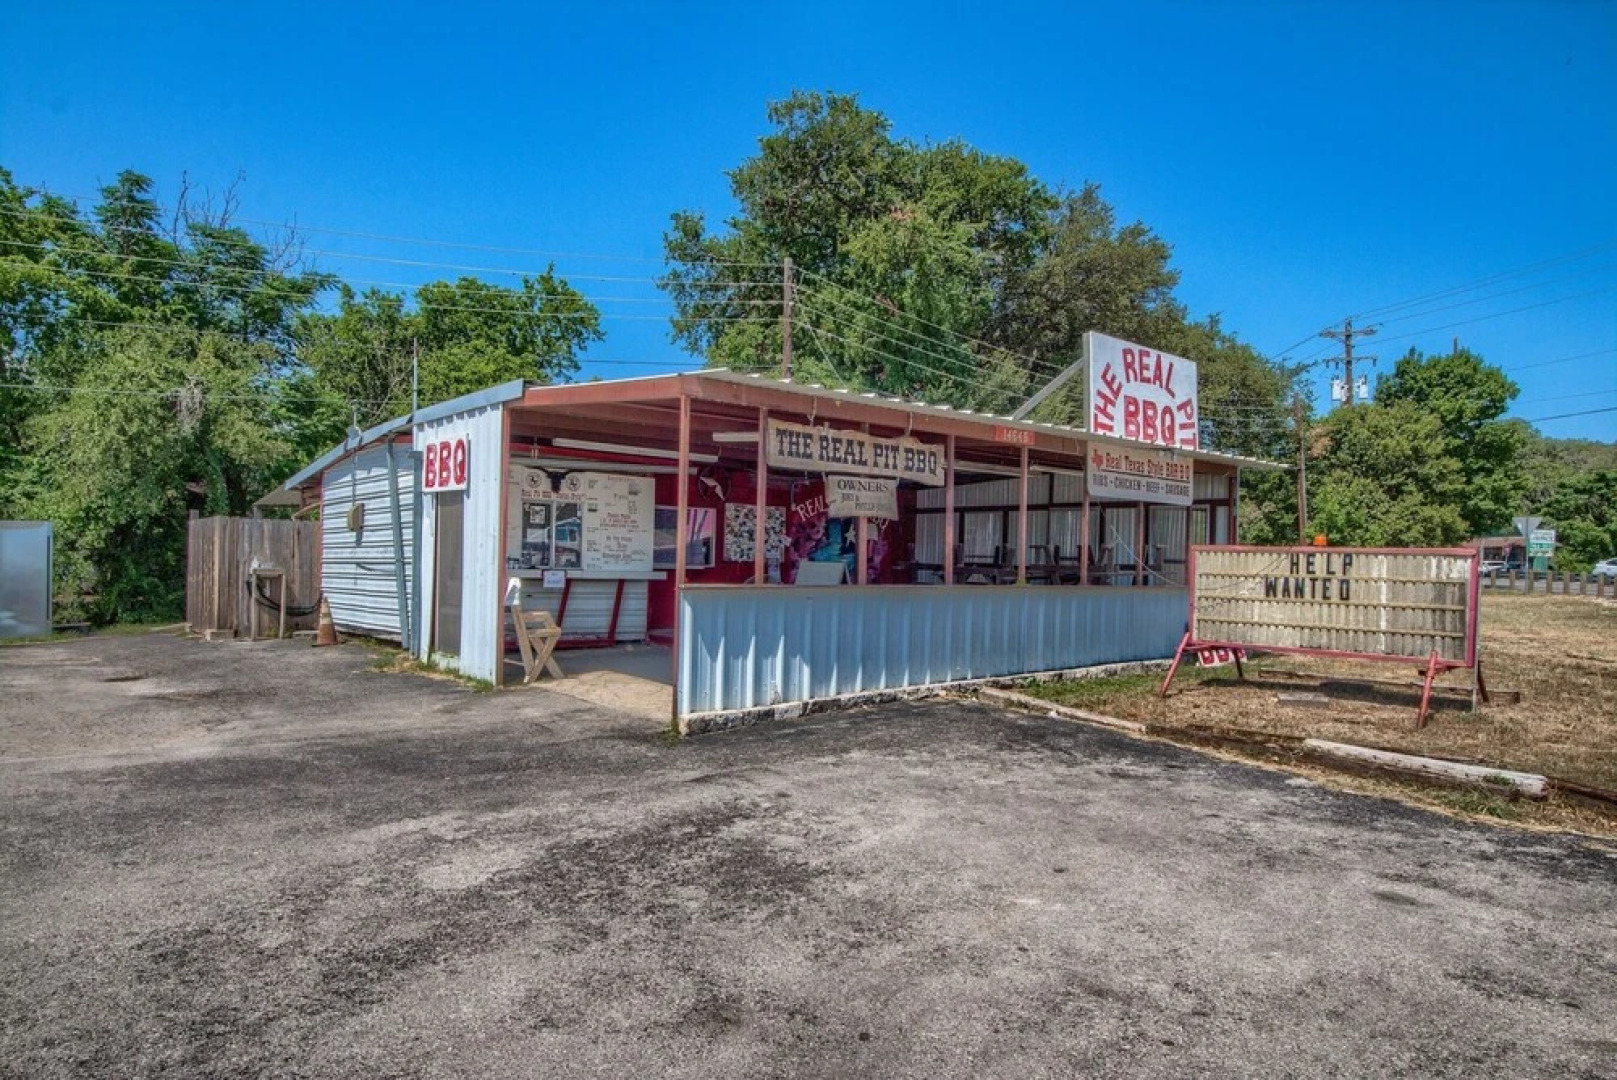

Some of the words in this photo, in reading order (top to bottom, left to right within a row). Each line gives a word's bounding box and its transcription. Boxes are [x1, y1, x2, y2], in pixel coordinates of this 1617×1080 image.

[1093, 361, 1123, 433] THE
[1122, 347, 1176, 399] REAL
[1177, 398, 1197, 448] PIT
[1123, 395, 1176, 446] BBQ
[425, 438, 467, 488] BBQ
[775, 427, 813, 460] THE
[818, 434, 868, 467] REAL
[872, 441, 900, 470] PIT
[903, 447, 937, 477] BBQ
[1106, 452, 1122, 470] Real
[1124, 455, 1144, 473] Texas
[837, 479, 889, 493] OWNERS
[1113, 476, 1141, 491] CHICKEN
[796, 495, 827, 521] REAL
[1289, 553, 1353, 576] HELP
[1265, 575, 1349, 600] WANTED
